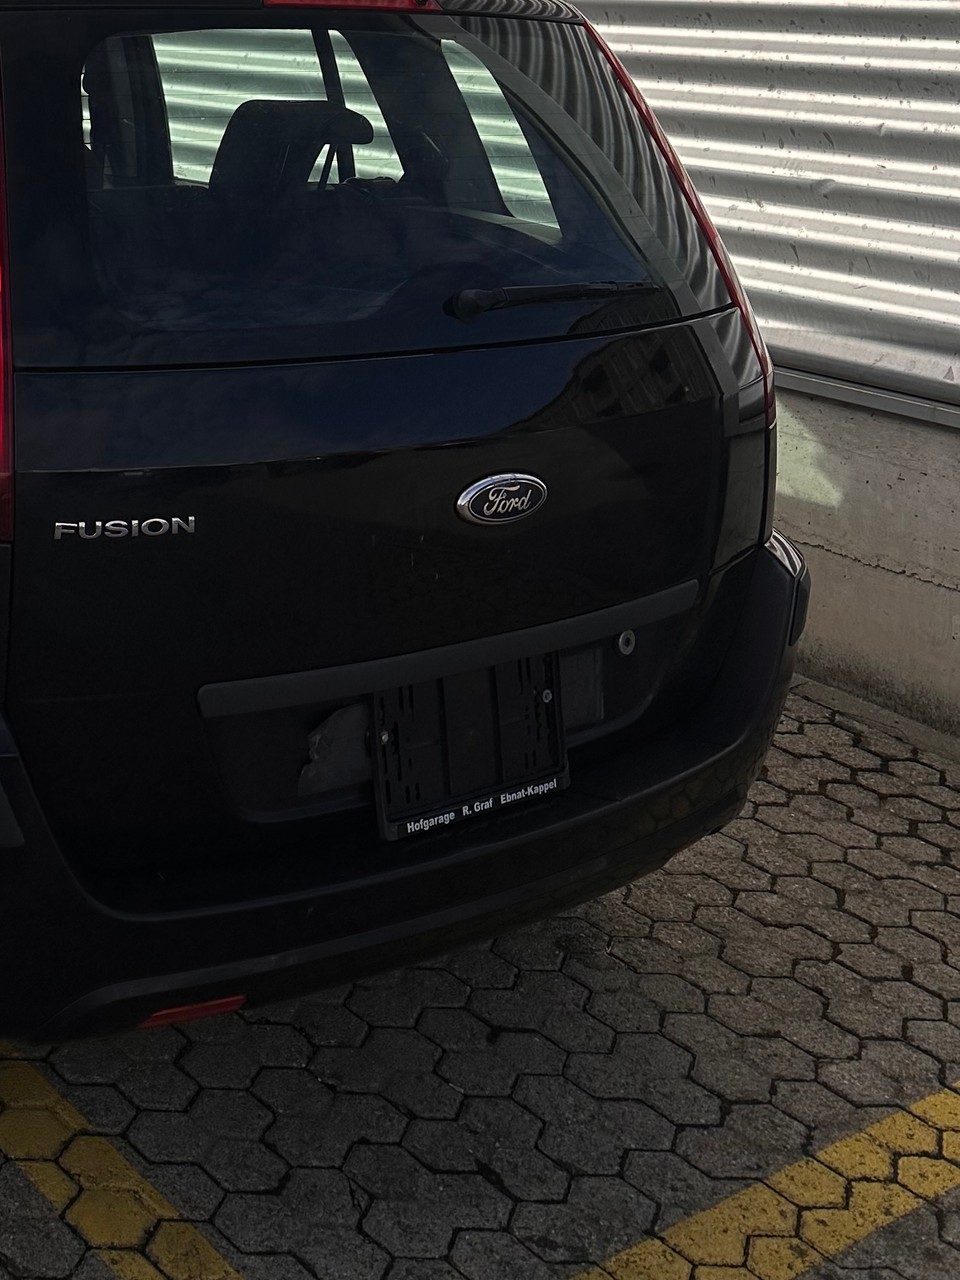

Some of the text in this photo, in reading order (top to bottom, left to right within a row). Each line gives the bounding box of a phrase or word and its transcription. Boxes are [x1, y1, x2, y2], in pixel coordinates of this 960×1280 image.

[483, 484, 532, 516] Ford
[53, 515, 195, 540] FUSION
[406, 778, 557, 833] Hofgarage R. Graf Ebnat-Kappel
